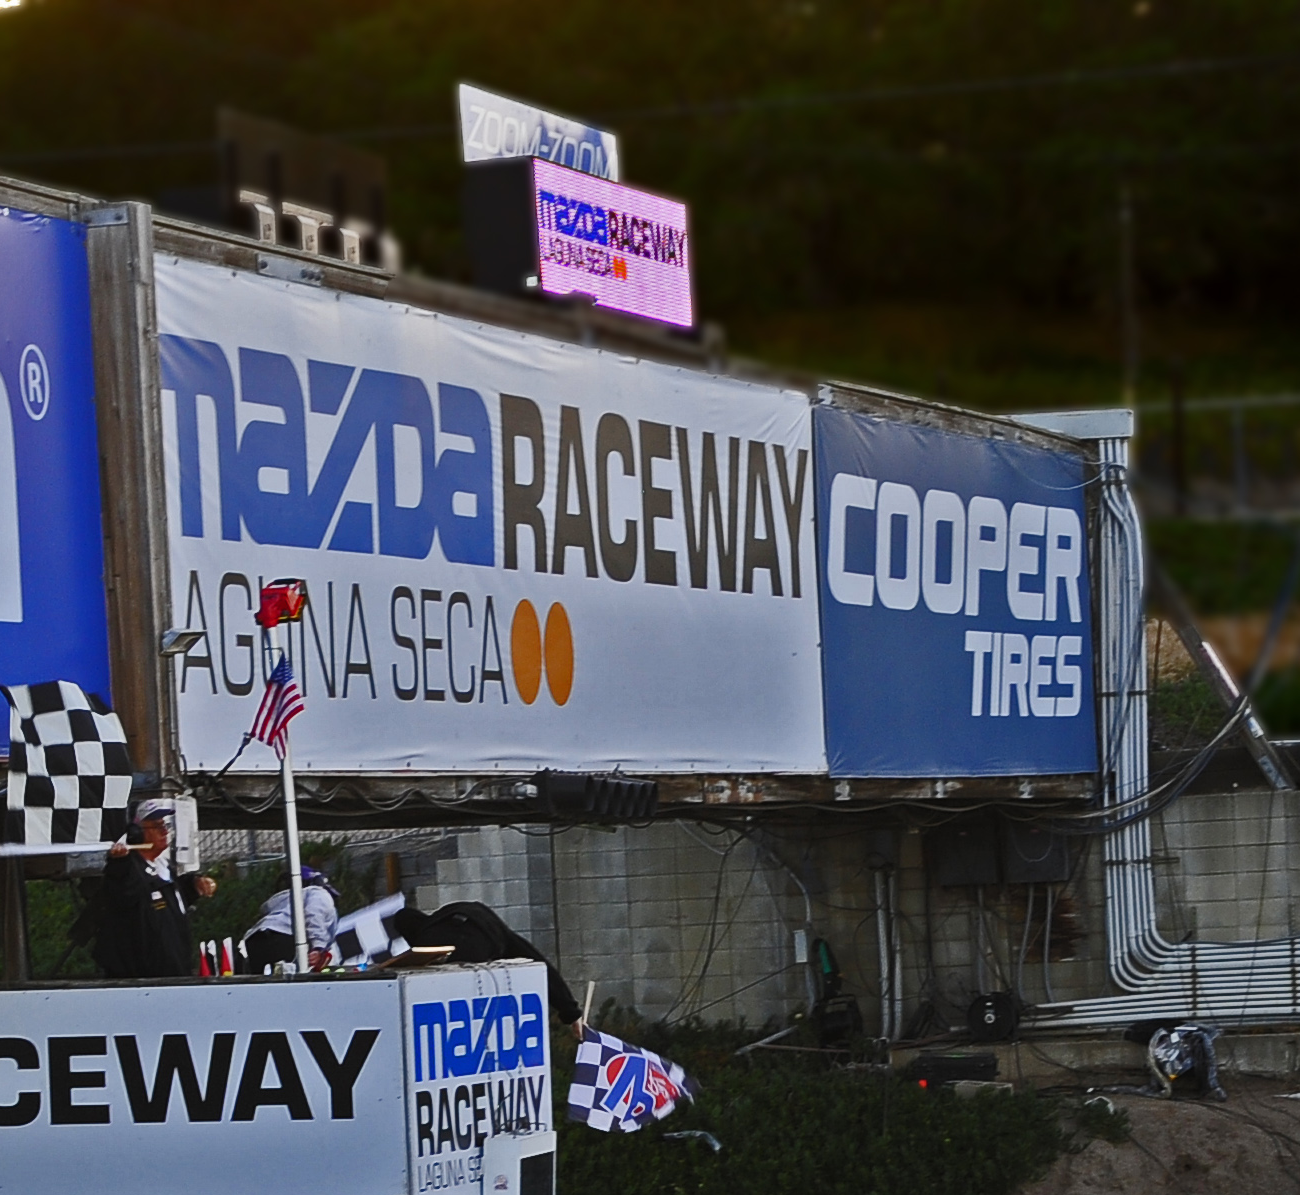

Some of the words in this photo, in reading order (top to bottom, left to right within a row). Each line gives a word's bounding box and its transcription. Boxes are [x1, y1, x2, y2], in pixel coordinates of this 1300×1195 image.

[500, 392, 808, 599] RACEWAY
[828, 473, 1083, 623] COOPER
[391, 585, 508, 705] SECA
[965, 630, 1083, 718] TIRES
[416, 1074, 544, 1158] RACEWAY
[418, 1159, 466, 1192] LAGUNA
[468, 1154, 483, 1183] SE
